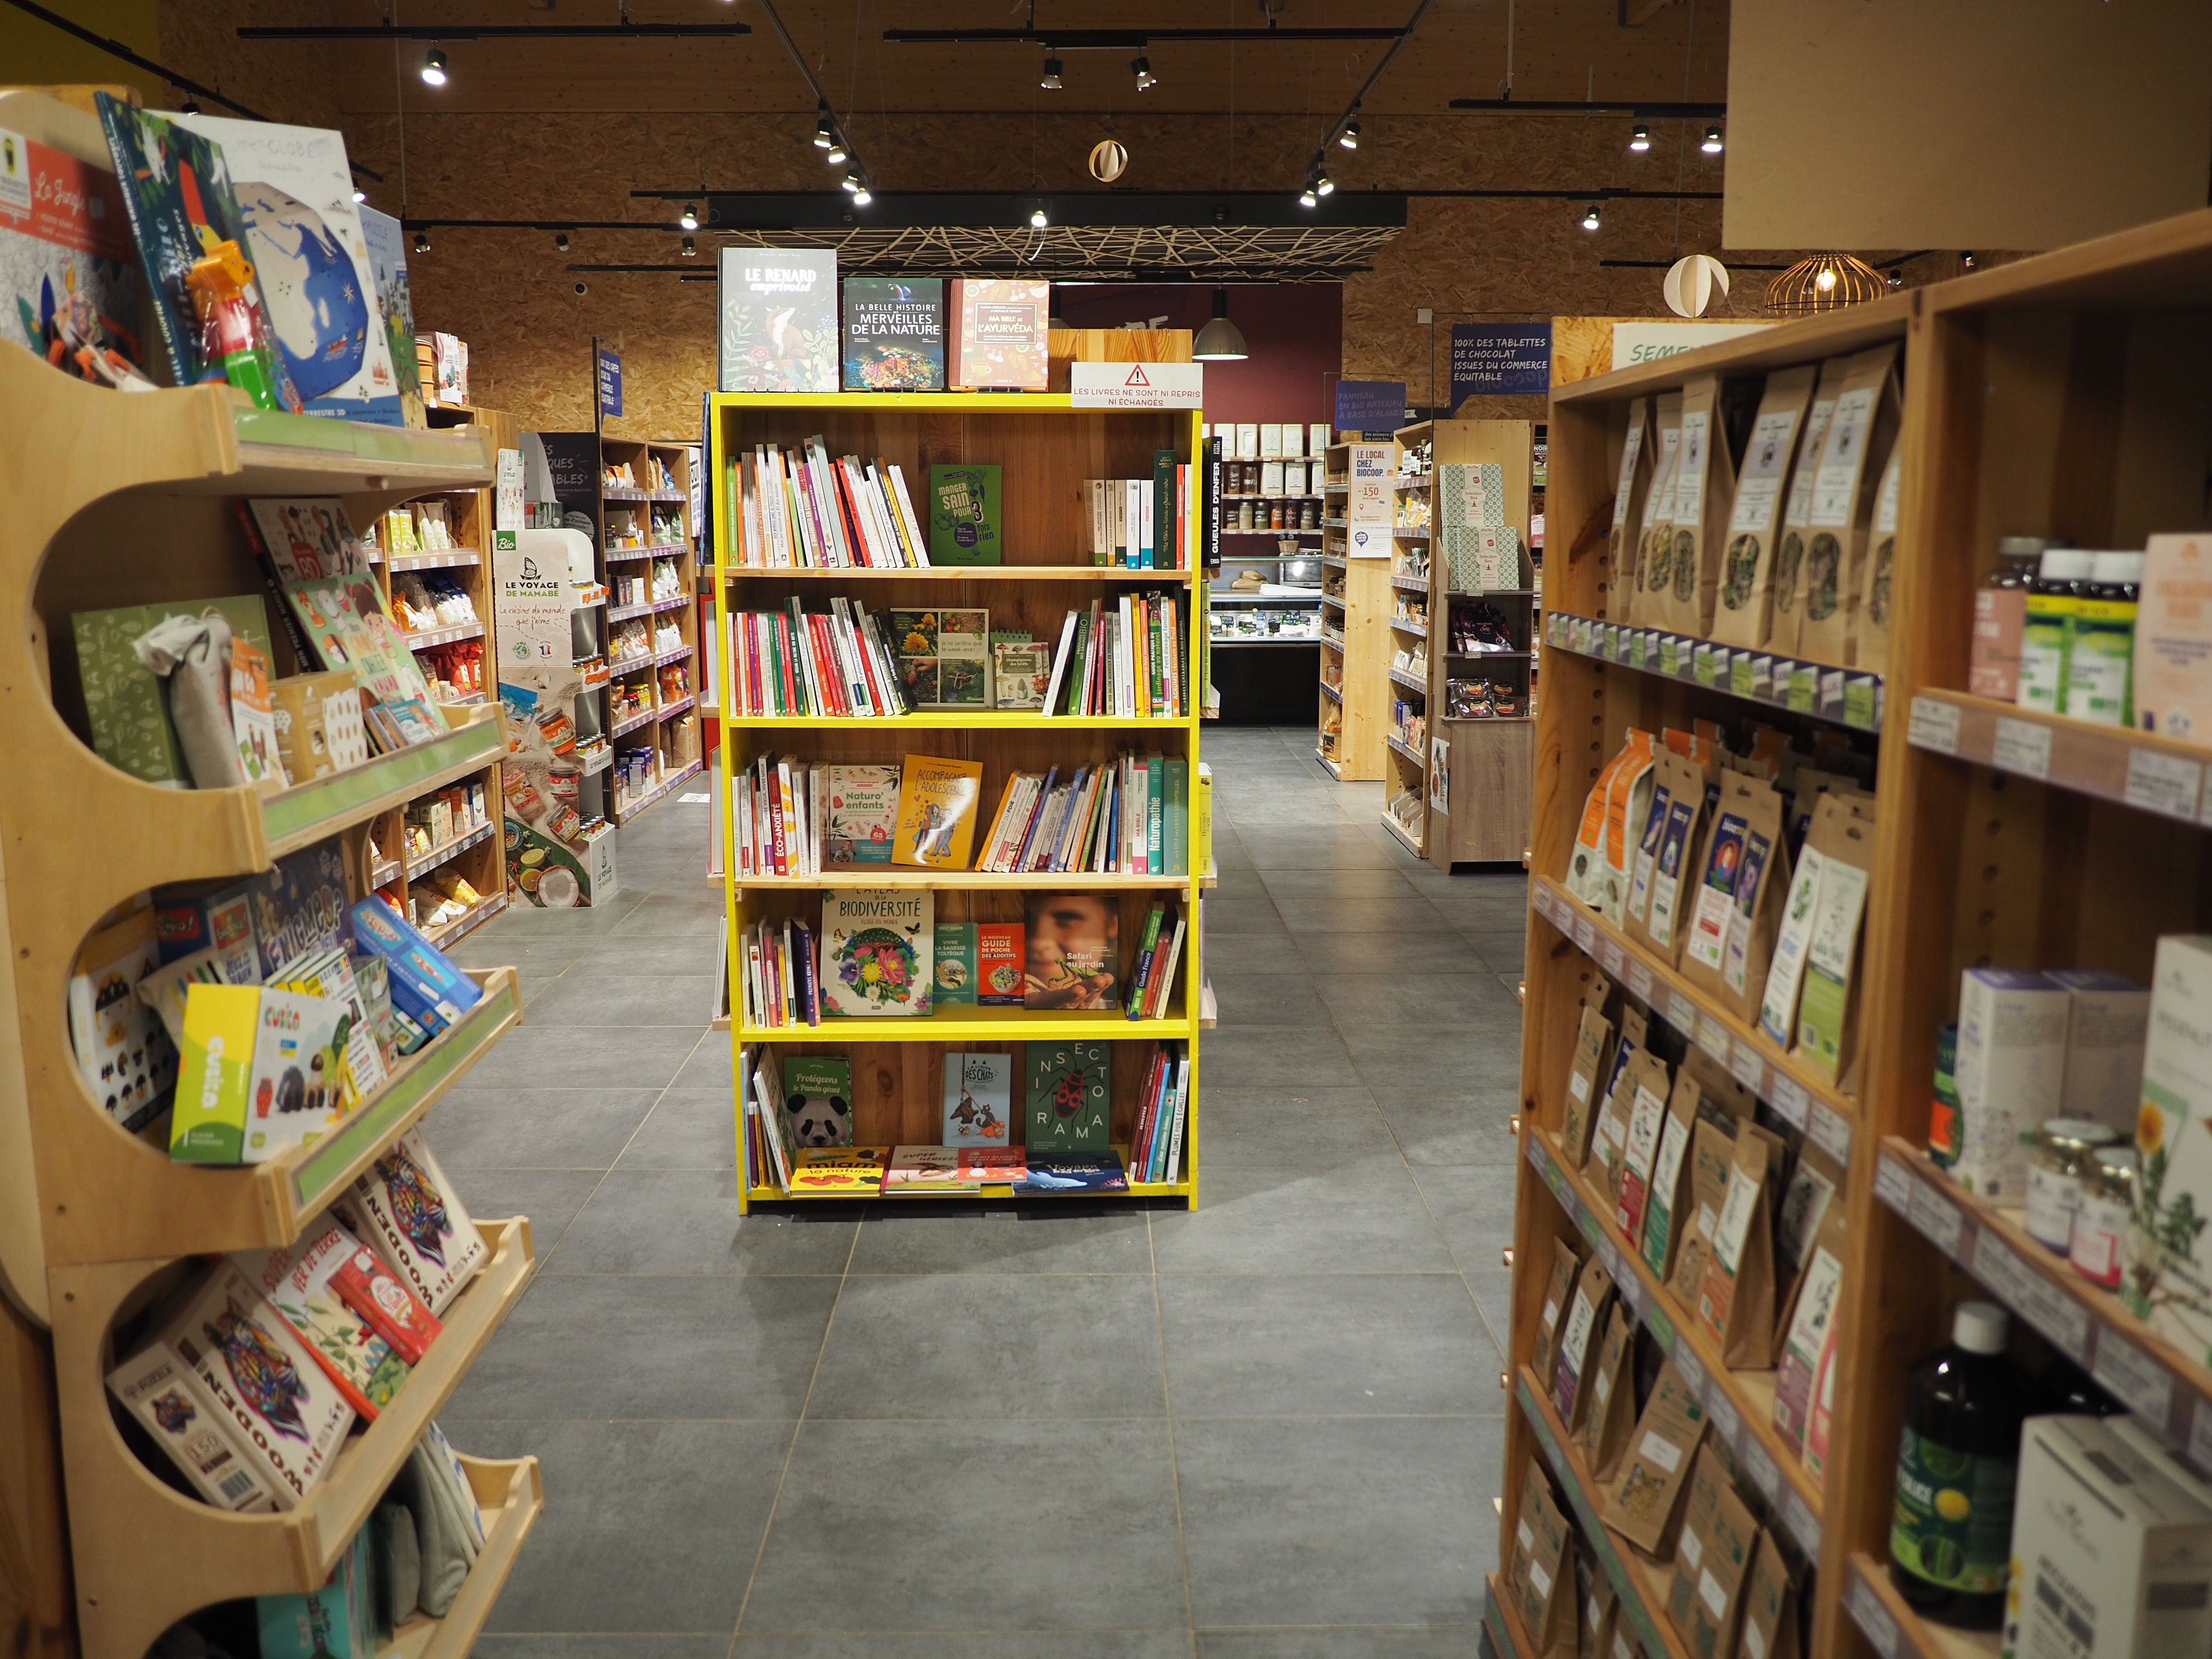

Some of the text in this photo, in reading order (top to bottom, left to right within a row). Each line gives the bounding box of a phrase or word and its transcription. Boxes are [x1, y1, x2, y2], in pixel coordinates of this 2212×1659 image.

[745, 268, 816, 282] LE RENARD
[860, 314, 932, 324] MERVEILLES
[852, 325, 940, 335] DE LA NATURE
[978, 323, 1034, 333] L'AYURVÉDA
[1455, 338, 1546, 348] 100% DES TABLETTES
[1469, 350, 1516, 359] CHOCOLAT
[1455, 361, 1548, 370] ISSUES DU COMMERCE
[1454, 371, 1502, 381] ÉQUITABLE
[1119, 397, 1163, 406] ÉCHANGÉS
[690, 465, 699, 484] OUI
[938, 483, 967, 496] MANGER
[1363, 487, 1379, 496] 150
[802, 493, 810, 510] CUISINE
[942, 492, 970, 510] SAIN
[953, 506, 972, 518] POUR
[971, 500, 984, 523] 3
[806, 518, 817, 547] S'ORGANISER
[977, 523, 990, 532] fois
[979, 532, 994, 541] rien
[498, 538, 515, 549] Bio
[499, 604, 565, 614] La cuisine du monde
[516, 616, 550, 631] que j'aime
[917, 769, 967, 782] ACCOMPAGNER
[846, 792, 884, 800] Naturo'
[846, 801, 884, 809] enfants
[993, 835, 1001, 848] TOUT
[998, 820, 1007, 835] VIENT
[1007, 800, 1015, 813] FOIE
[1149, 797, 1161, 851] Naturopathie
[772, 803, 784, 857] ÉCO-ANXIÉTÉ
[840, 898, 921, 916] BIODIVERSITÉ
[1080, 960, 1104, 969] jardin
[1139, 952, 1152, 987] Guide France
[796, 1073, 838, 1084] Protégeons
[965, 1069, 994, 1080] DES CHATS
[822, 1086, 841, 1094] géant
[806, 1160, 877, 1168] miam
[368, 1197, 433, 1308] WOODEN
[291, 1227, 342, 1294] VER DE TERRE
[203, 1370, 303, 1496] WOODEN
